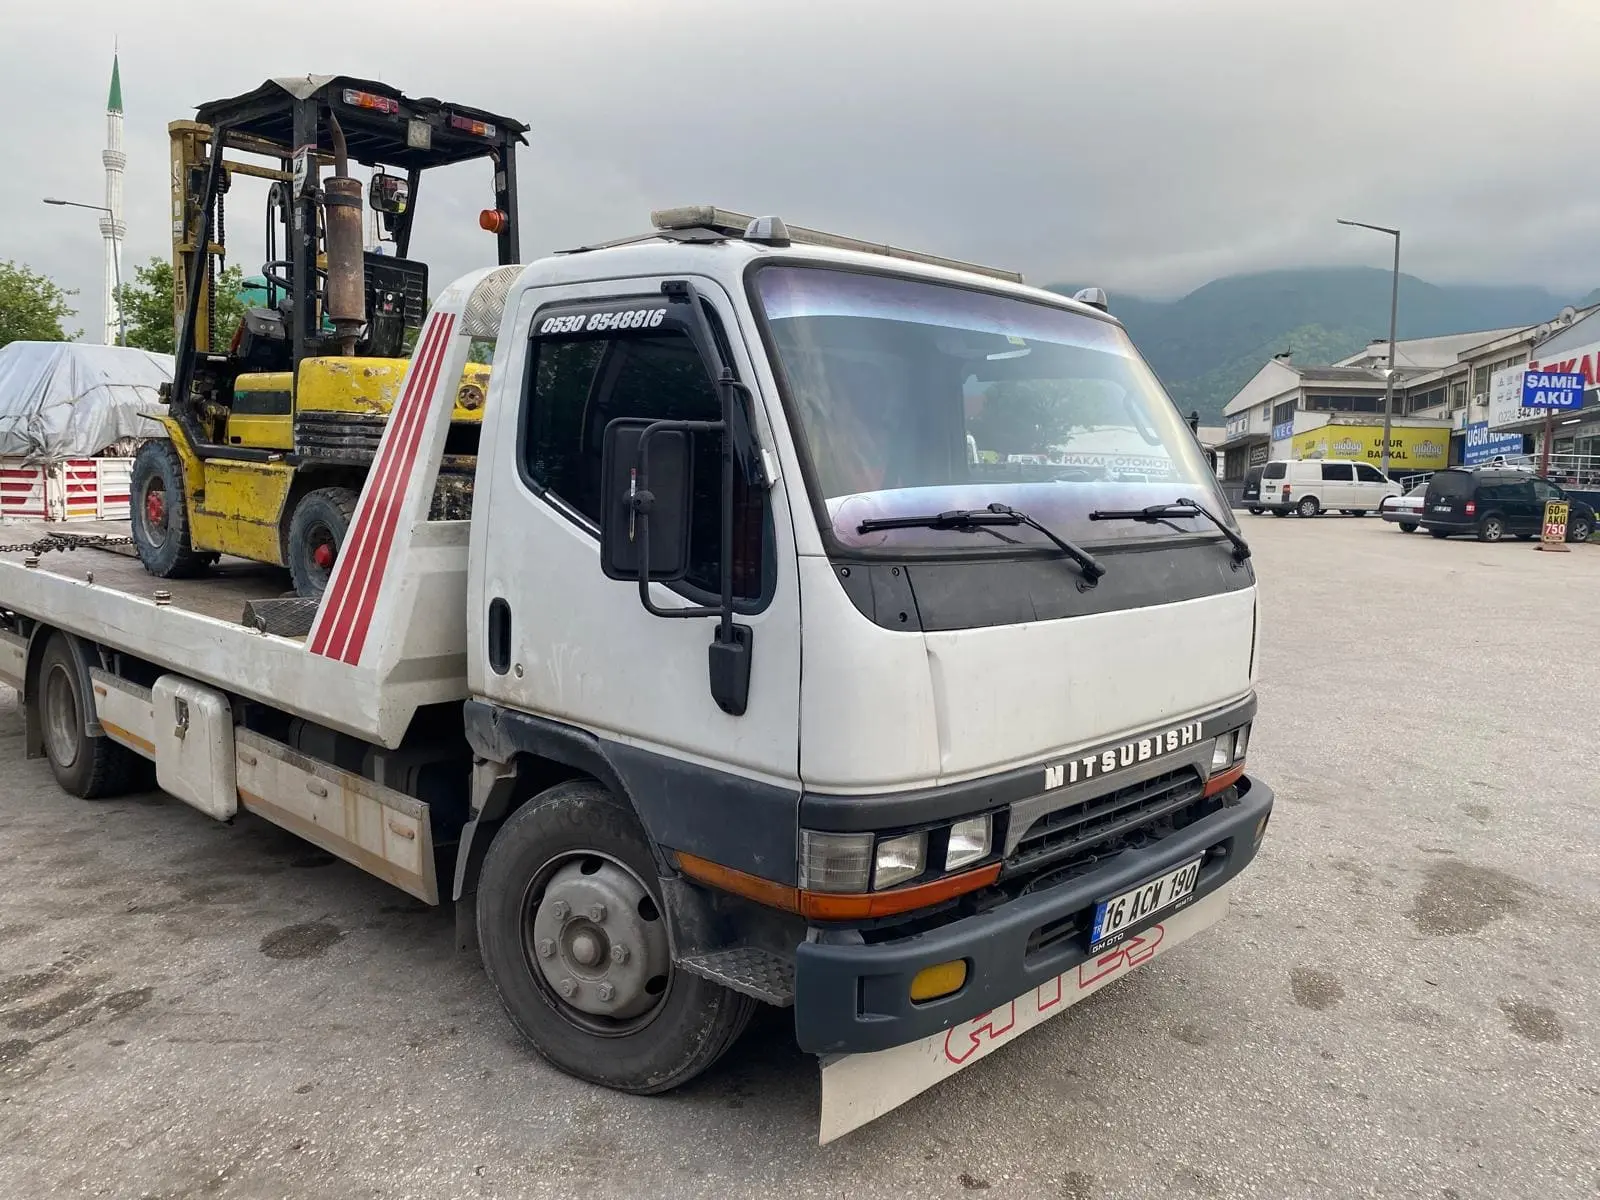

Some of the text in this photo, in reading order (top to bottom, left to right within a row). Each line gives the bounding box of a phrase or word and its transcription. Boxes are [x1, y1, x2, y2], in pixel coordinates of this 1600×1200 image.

[540, 308, 667, 333] 0530 8548816
[1533, 389, 1573, 405] AKÜ
[1374, 439, 1403, 448] UUR
[1467, 425, 1488, 448] UĞUR
[1548, 505, 1560, 515] 60
[1545, 523, 1566, 535] 750
[1044, 721, 1203, 791] MITSUBISHI
[1093, 924, 1102, 934] TR
[1105, 898, 1126, 933] 16
[1169, 864, 1197, 900] 190
[1106, 932, 1124, 946] OTO
